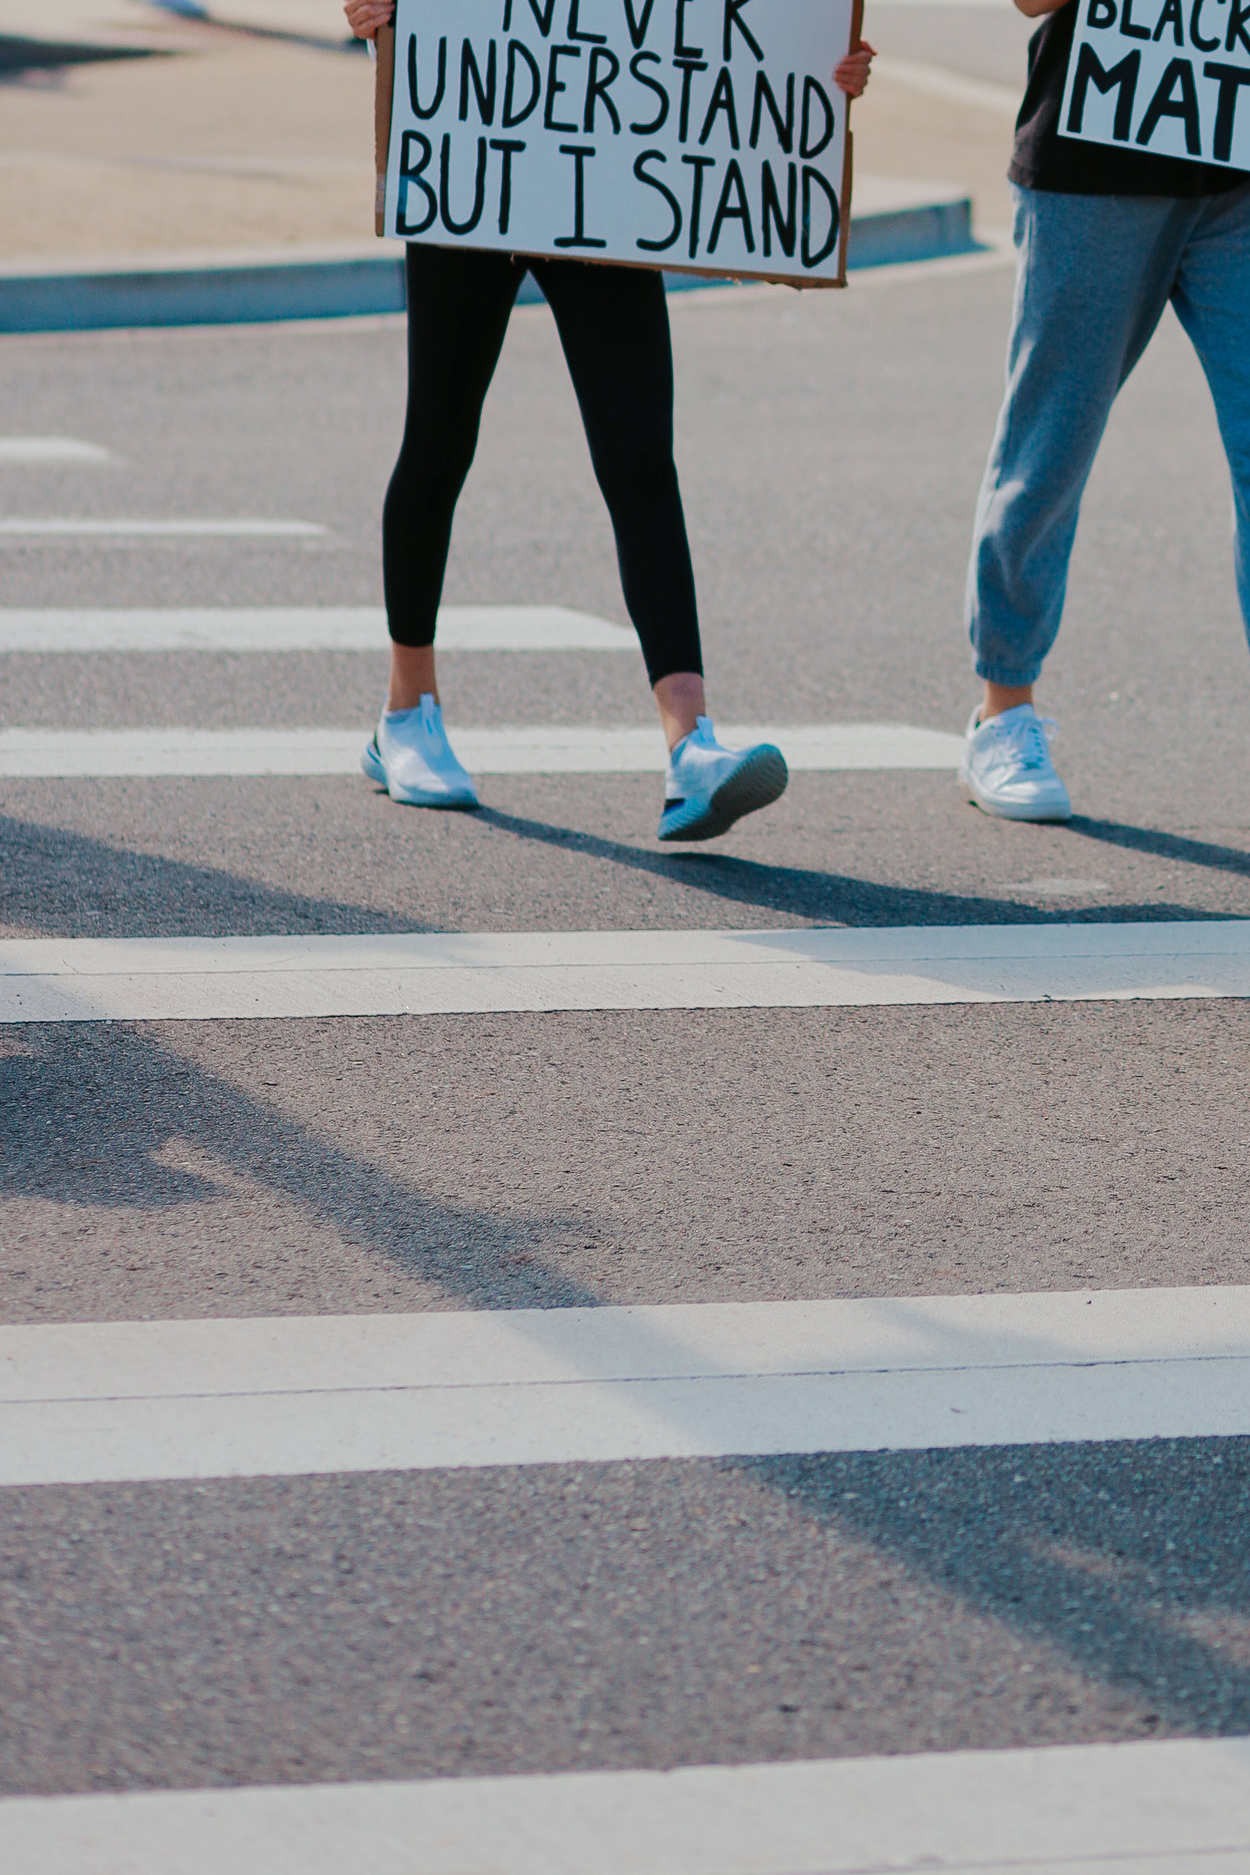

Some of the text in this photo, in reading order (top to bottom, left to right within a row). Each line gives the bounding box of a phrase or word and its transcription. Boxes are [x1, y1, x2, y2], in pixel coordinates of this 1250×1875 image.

[407, 32, 836, 160] UNDERSTAND
[395, 129, 841, 268] BUT I STAND
